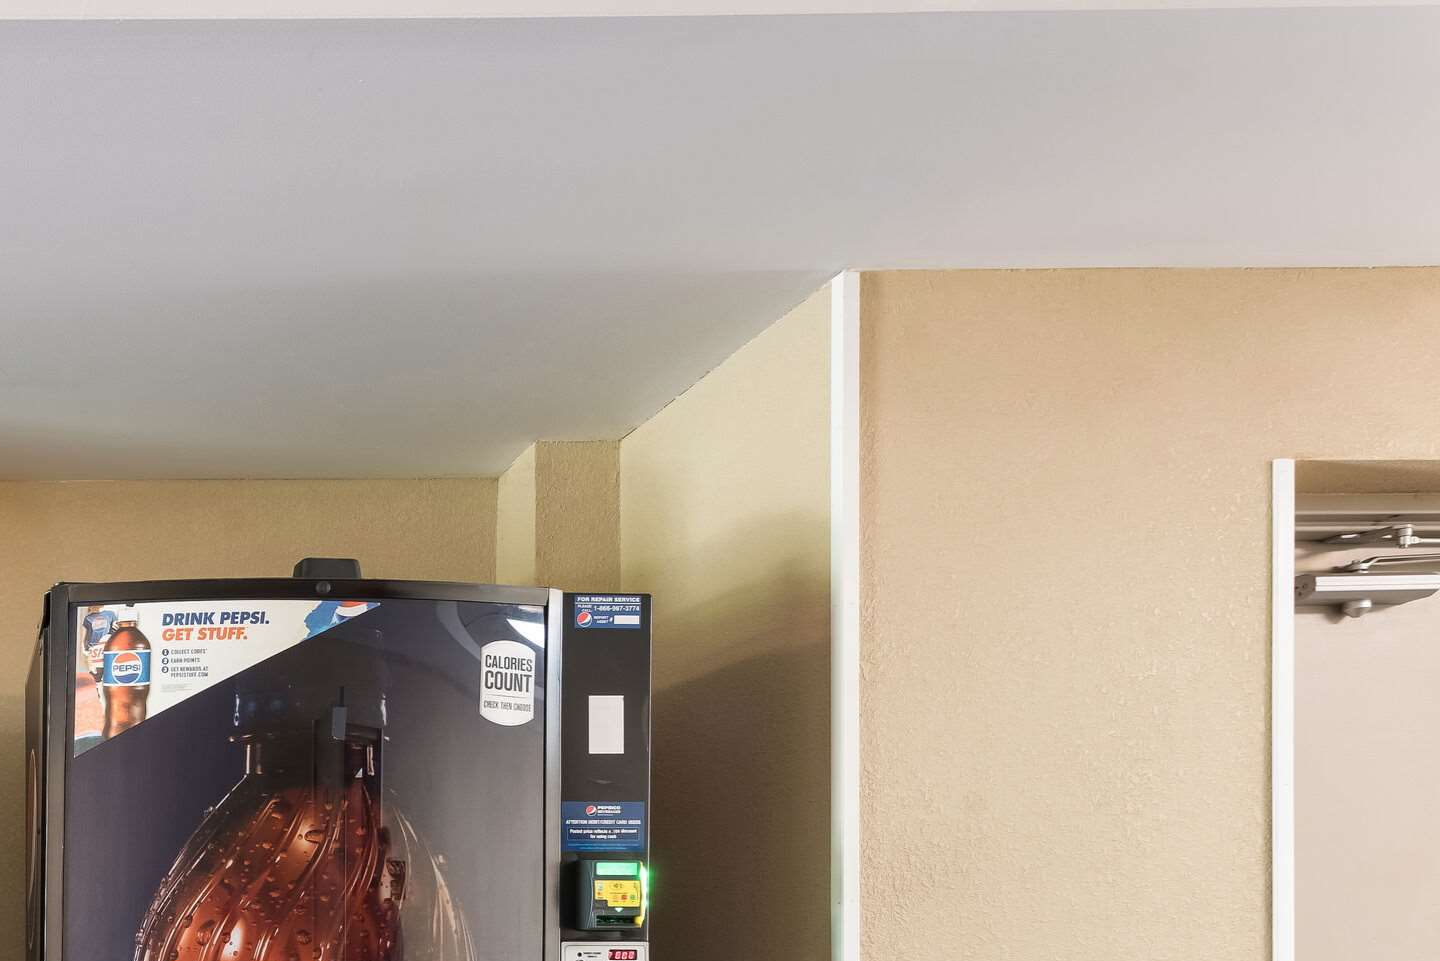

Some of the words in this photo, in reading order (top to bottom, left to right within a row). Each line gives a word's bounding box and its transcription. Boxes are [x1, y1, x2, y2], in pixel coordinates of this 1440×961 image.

[161, 612, 216, 626] DRINK
[219, 611, 270, 625] PEPSI.
[161, 628, 194, 641] GET
[197, 627, 248, 641] STUFF.
[112, 664, 141, 672] PEPSI
[484, 654, 533, 672] CALORIES
[484, 670, 532, 693] COUNT
[483, 699, 499, 710] CHECK
[500, 701, 513, 711] THEN
[513, 703, 532, 713] CHOOSE
